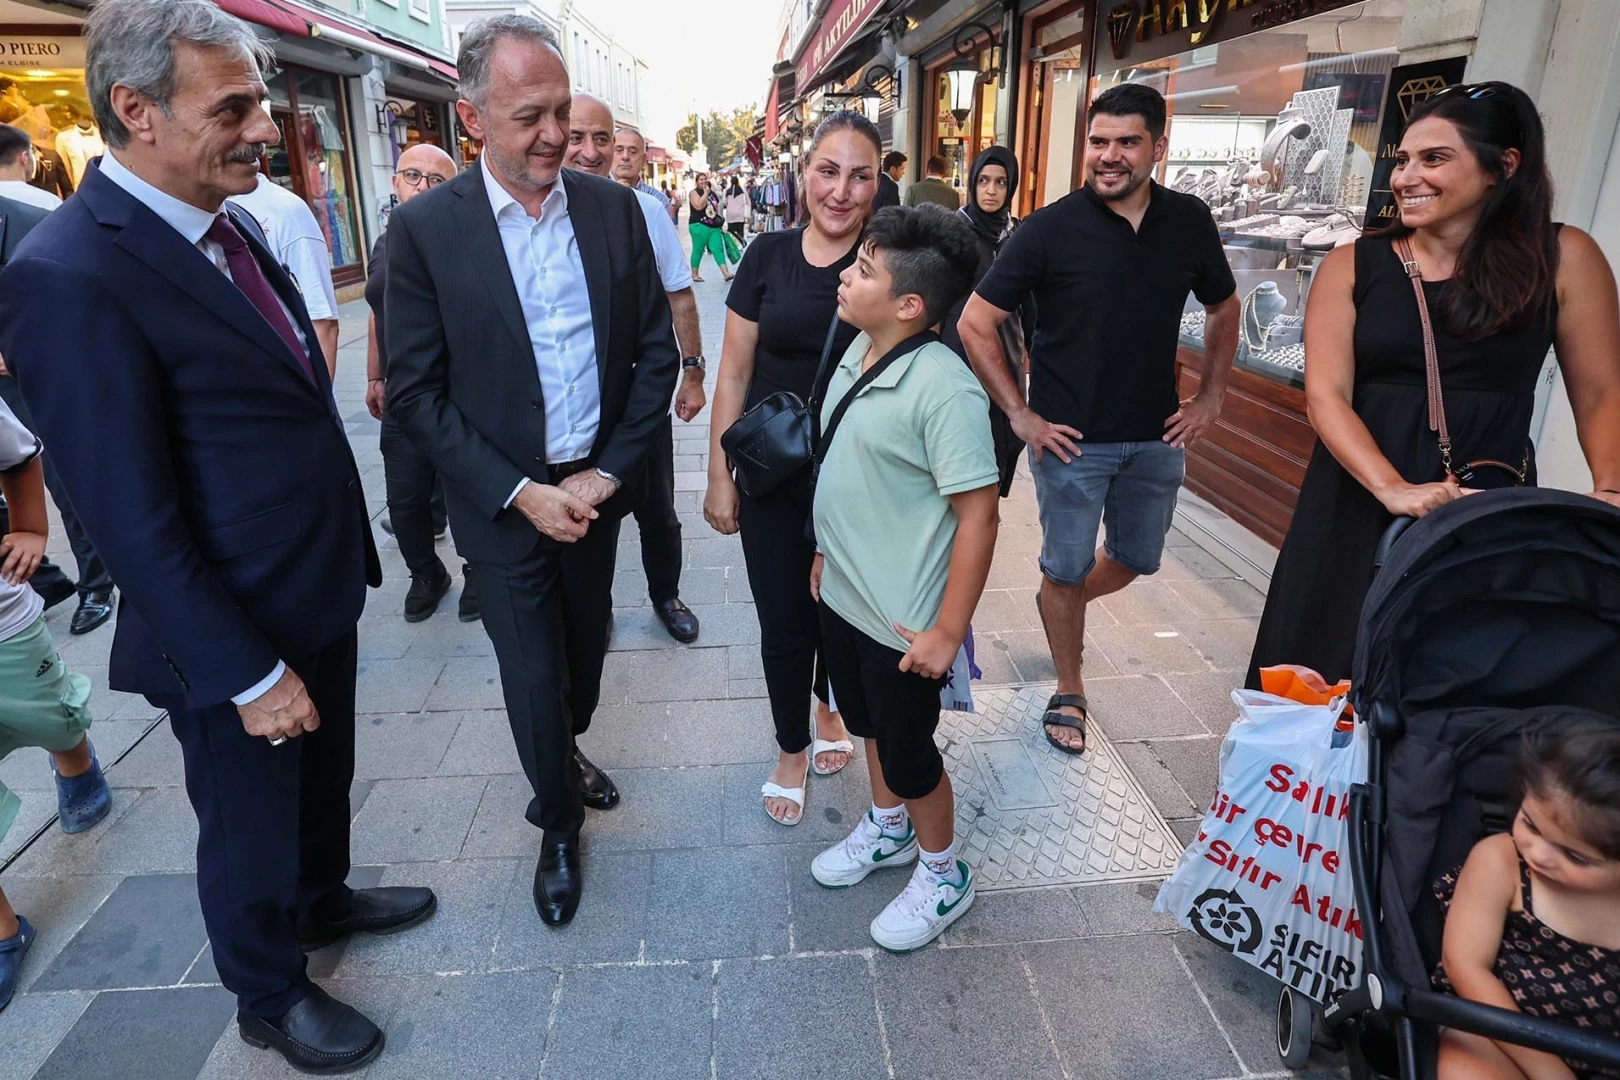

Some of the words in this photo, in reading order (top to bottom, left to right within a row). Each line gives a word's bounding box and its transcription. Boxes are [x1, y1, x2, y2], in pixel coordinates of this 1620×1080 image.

[9, 42, 60, 56] PIERO
[824, 0, 870, 58] AKYILD
[1291, 884, 1364, 942] Atık
[1259, 948, 1350, 1003] ATIK
[1269, 923, 1357, 987] SIFIR
